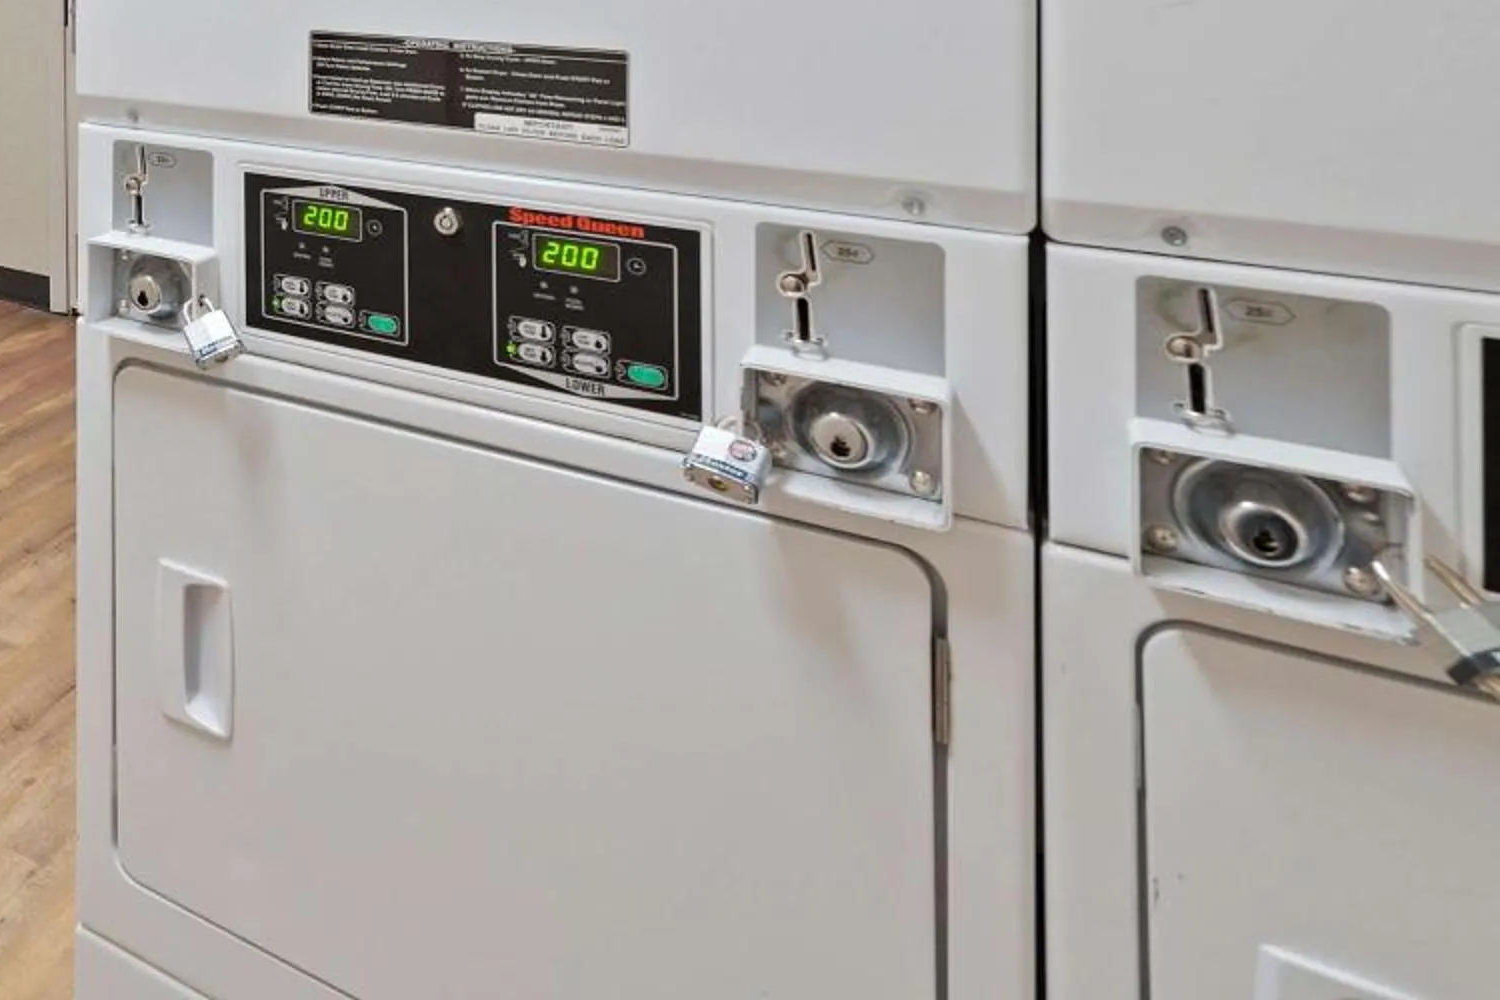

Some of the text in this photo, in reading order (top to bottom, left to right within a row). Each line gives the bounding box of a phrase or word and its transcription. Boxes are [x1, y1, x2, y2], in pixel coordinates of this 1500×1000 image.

[319, 188, 349, 200] UPPER
[303, 206, 349, 231] 200
[509, 207, 645, 239] Speed Queen
[542, 241, 599, 270] 200
[564, 378, 606, 397] LOWER
